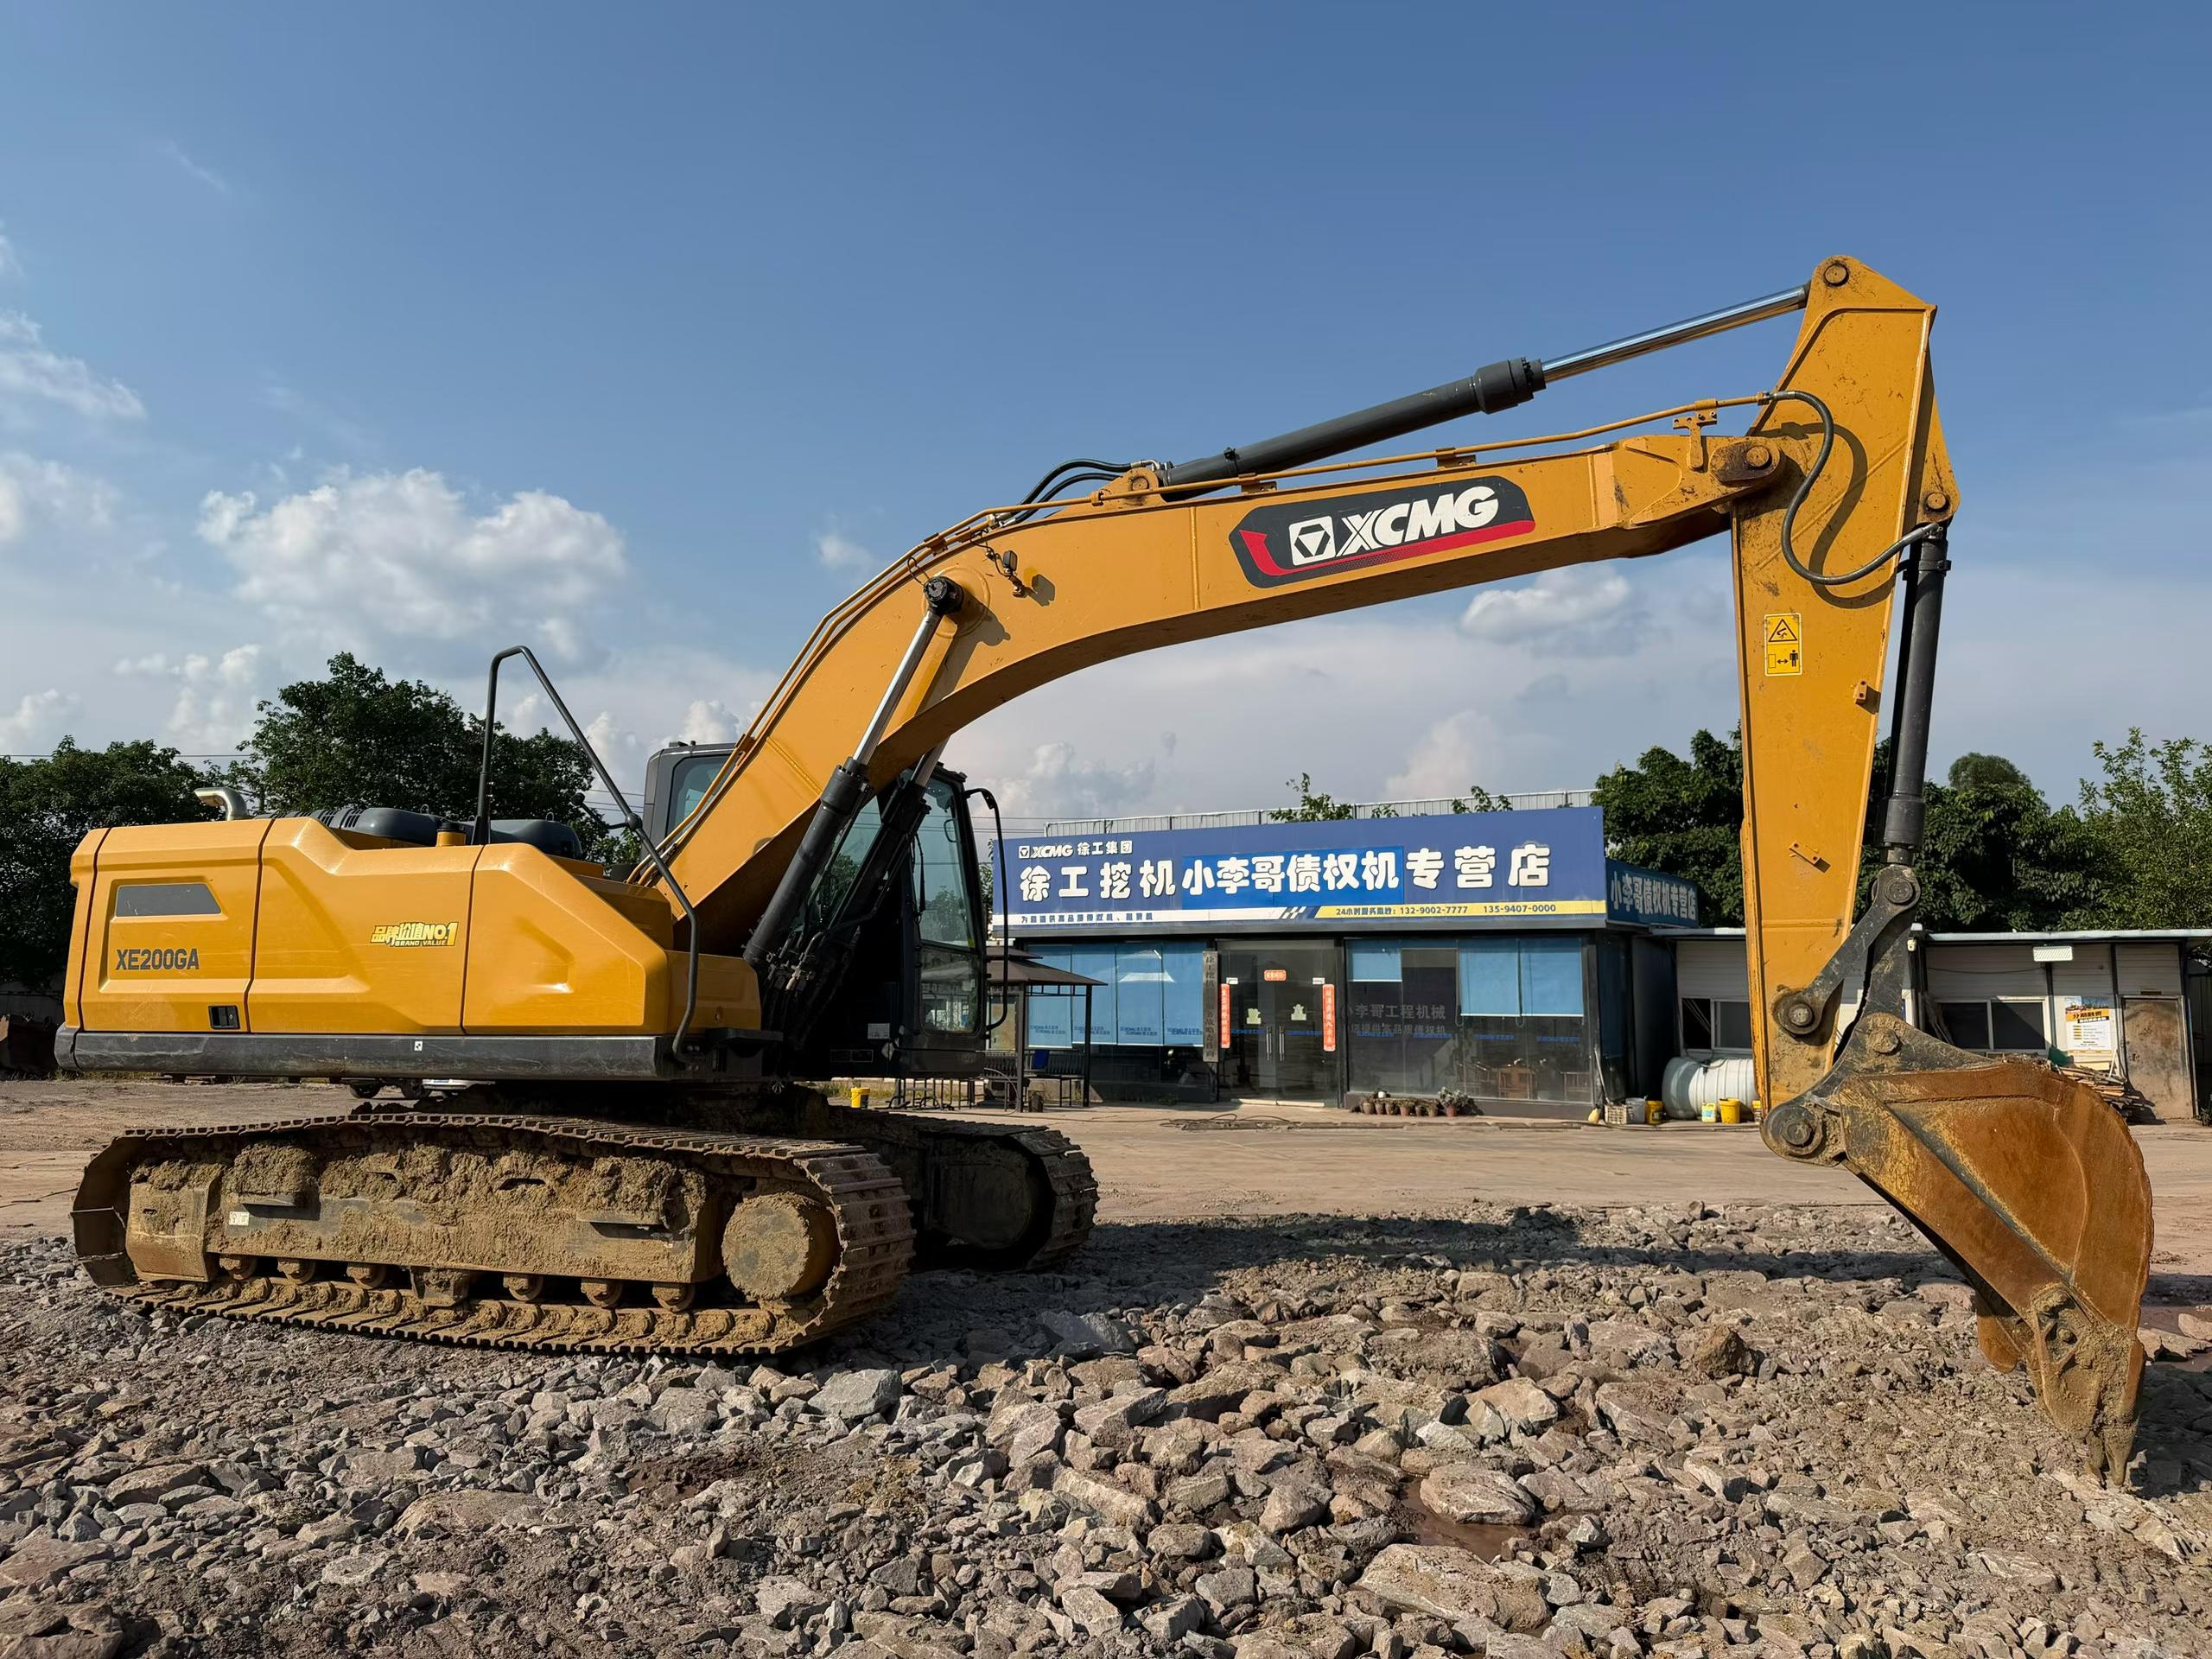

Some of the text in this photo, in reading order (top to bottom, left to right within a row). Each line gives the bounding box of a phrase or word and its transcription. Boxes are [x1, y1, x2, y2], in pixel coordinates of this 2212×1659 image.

[1336, 486, 1499, 556] XCMG
[1031, 840, 1134, 858] XCMG 徐工集团
[1611, 871, 1696, 920] 小李哥债权机专营店
[1484, 904, 1556, 913] 135-9407-0000
[116, 948, 200, 970] XE200GA
